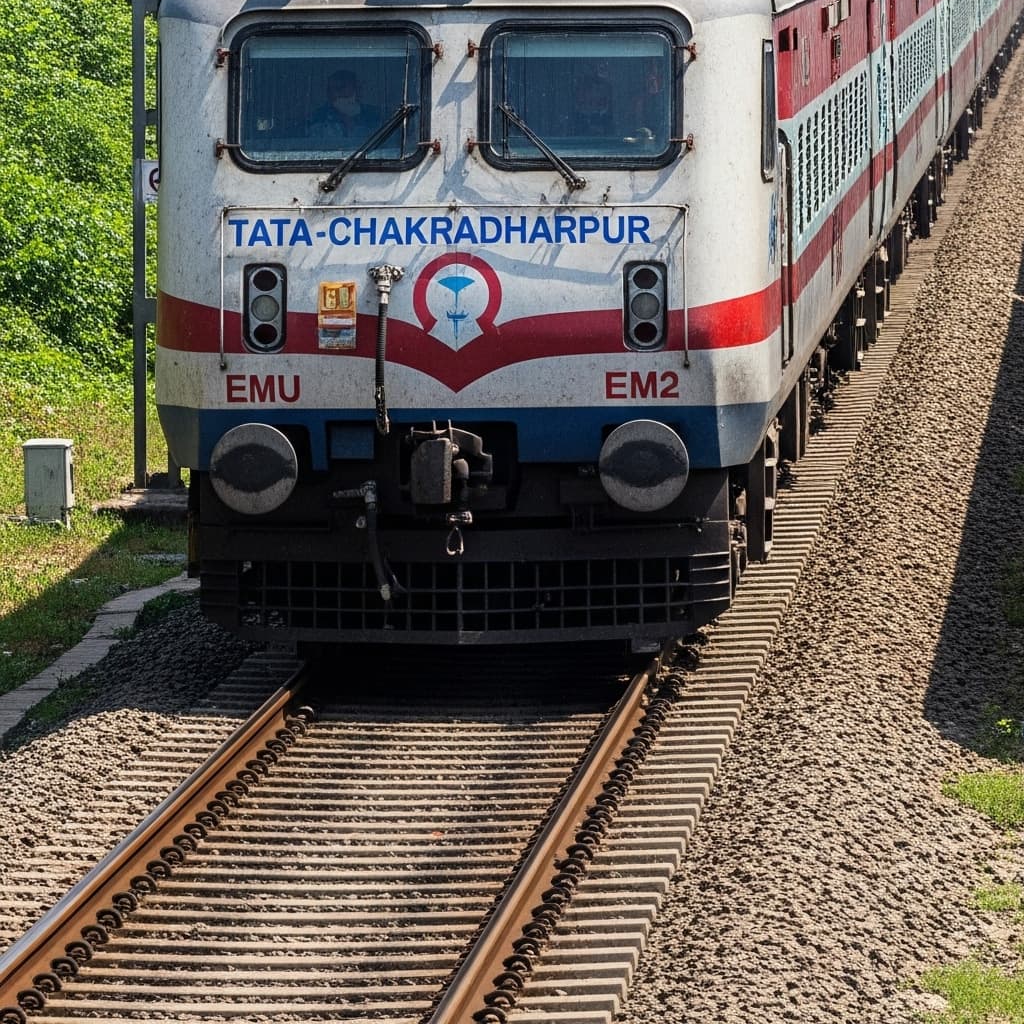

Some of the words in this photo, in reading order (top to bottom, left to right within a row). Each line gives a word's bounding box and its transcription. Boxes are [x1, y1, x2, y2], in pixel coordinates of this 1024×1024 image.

[229, 215, 652, 247] TATA-CHAKRADHARPUR
[226, 374, 301, 403] EMU
[605, 371, 680, 400] EM2
